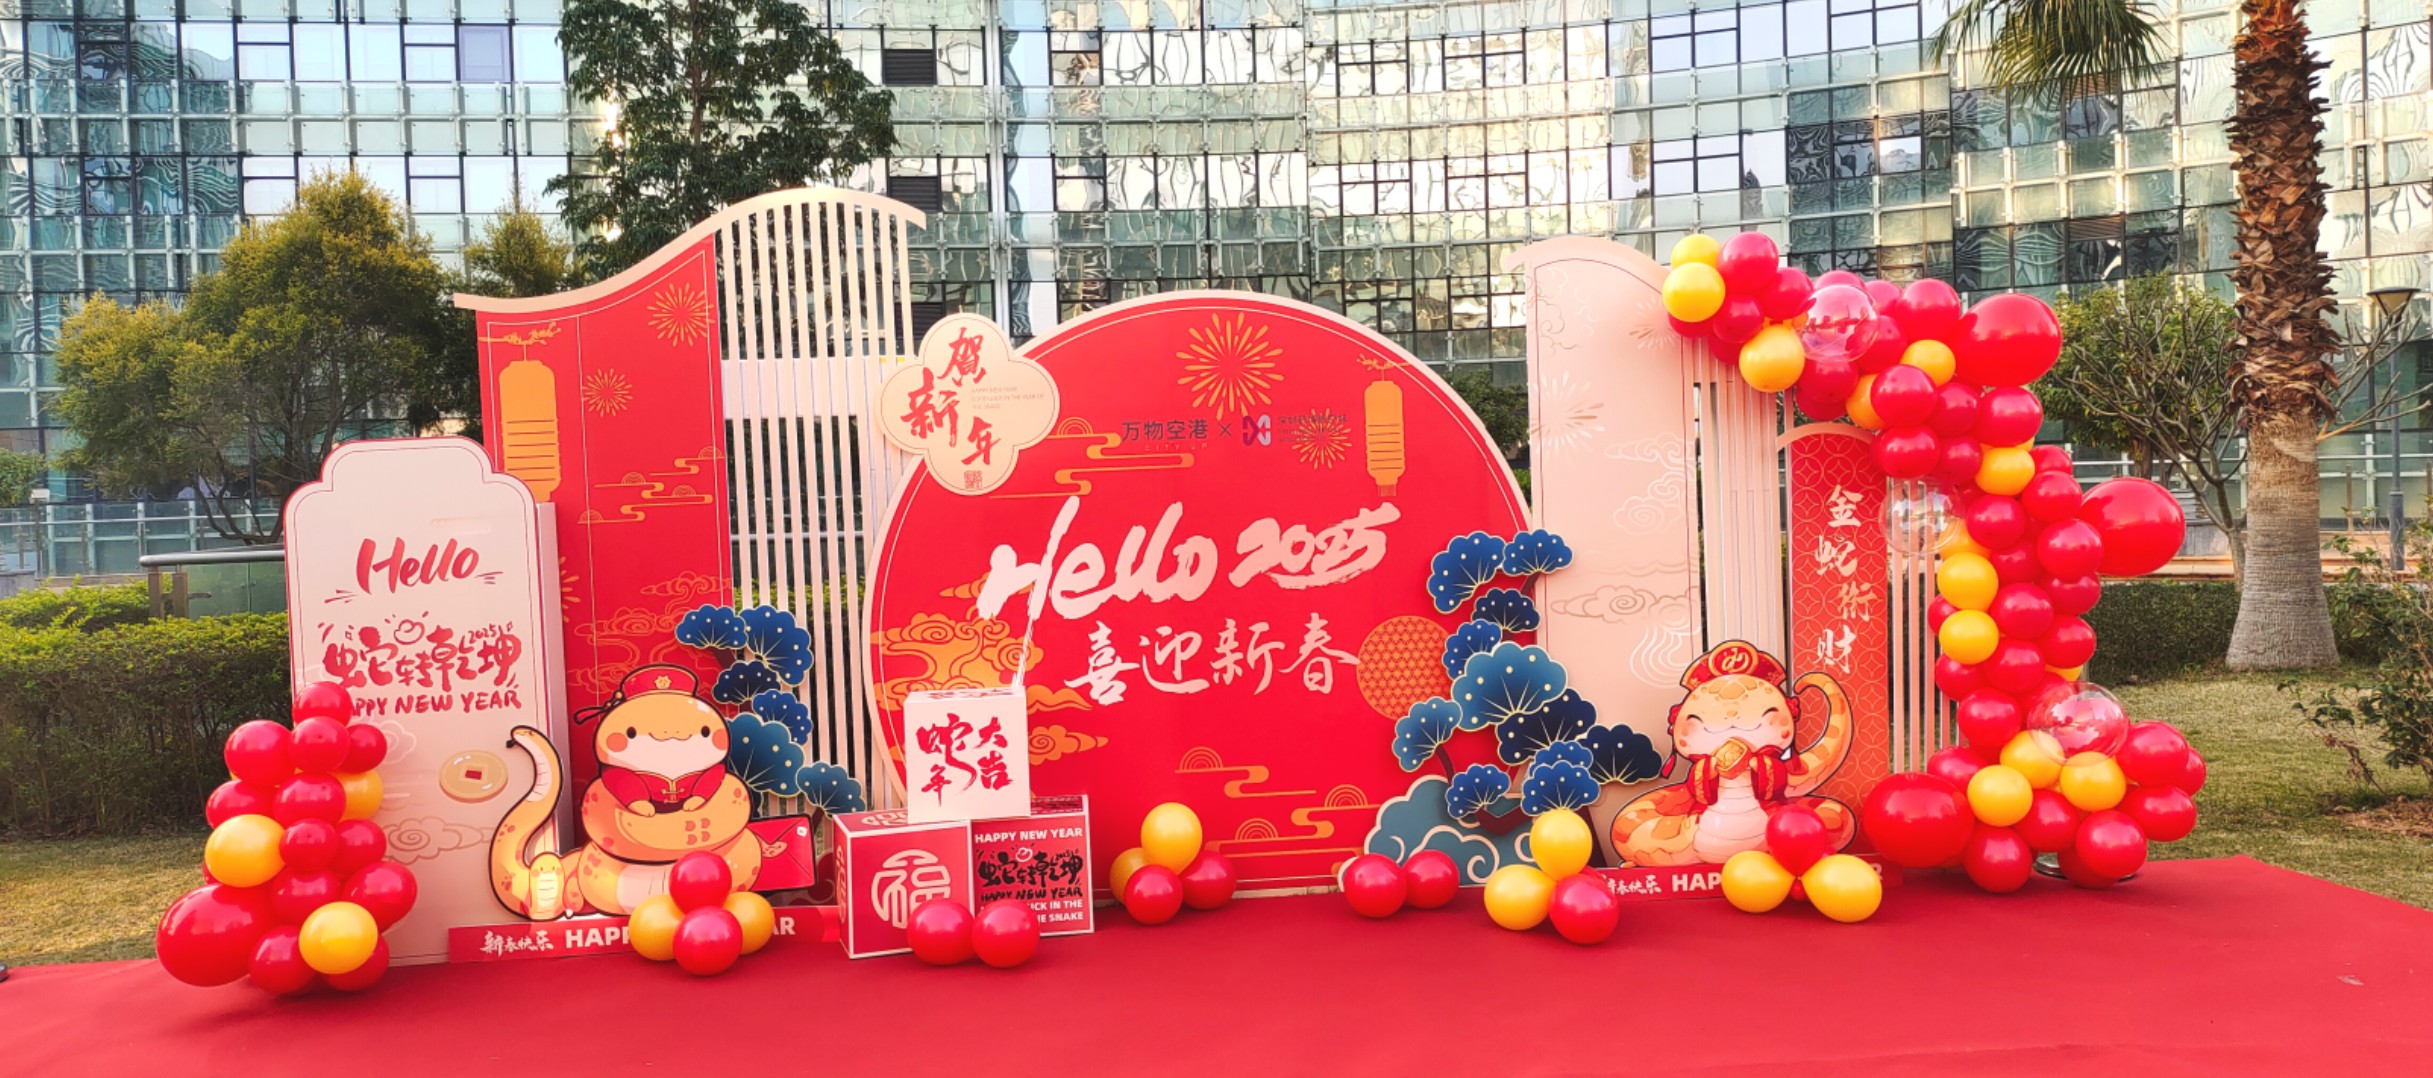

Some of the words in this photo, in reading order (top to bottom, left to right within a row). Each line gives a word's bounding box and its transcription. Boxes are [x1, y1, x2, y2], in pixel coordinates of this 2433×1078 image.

[1121, 418, 1208, 442] 万物空港
[356, 537, 480, 594] Hello
[976, 495, 1219, 620] Hello
[1228, 501, 1401, 590] 2025
[468, 623, 498, 645] 2025
[1064, 612, 1362, 706] 喜迎新春
[351, 697, 388, 717] PPY
[395, 694, 454, 714] NEW
[461, 689, 522, 713] YEAR
[975, 832, 1016, 843] HAPPY
[1019, 830, 1048, 841] NEW
[1050, 827, 1083, 838] YEAR
[871, 849, 951, 930] 福
[1016, 888, 1047, 900] NEW
[1051, 887, 1083, 899] YEAR
[1671, 872, 1722, 892] HAP
[1050, 901, 1061, 909] IN
[1063, 899, 1083, 908] THE
[1049, 911, 1083, 922] SNAKE
[479, 929, 554, 956] 新春快乐
